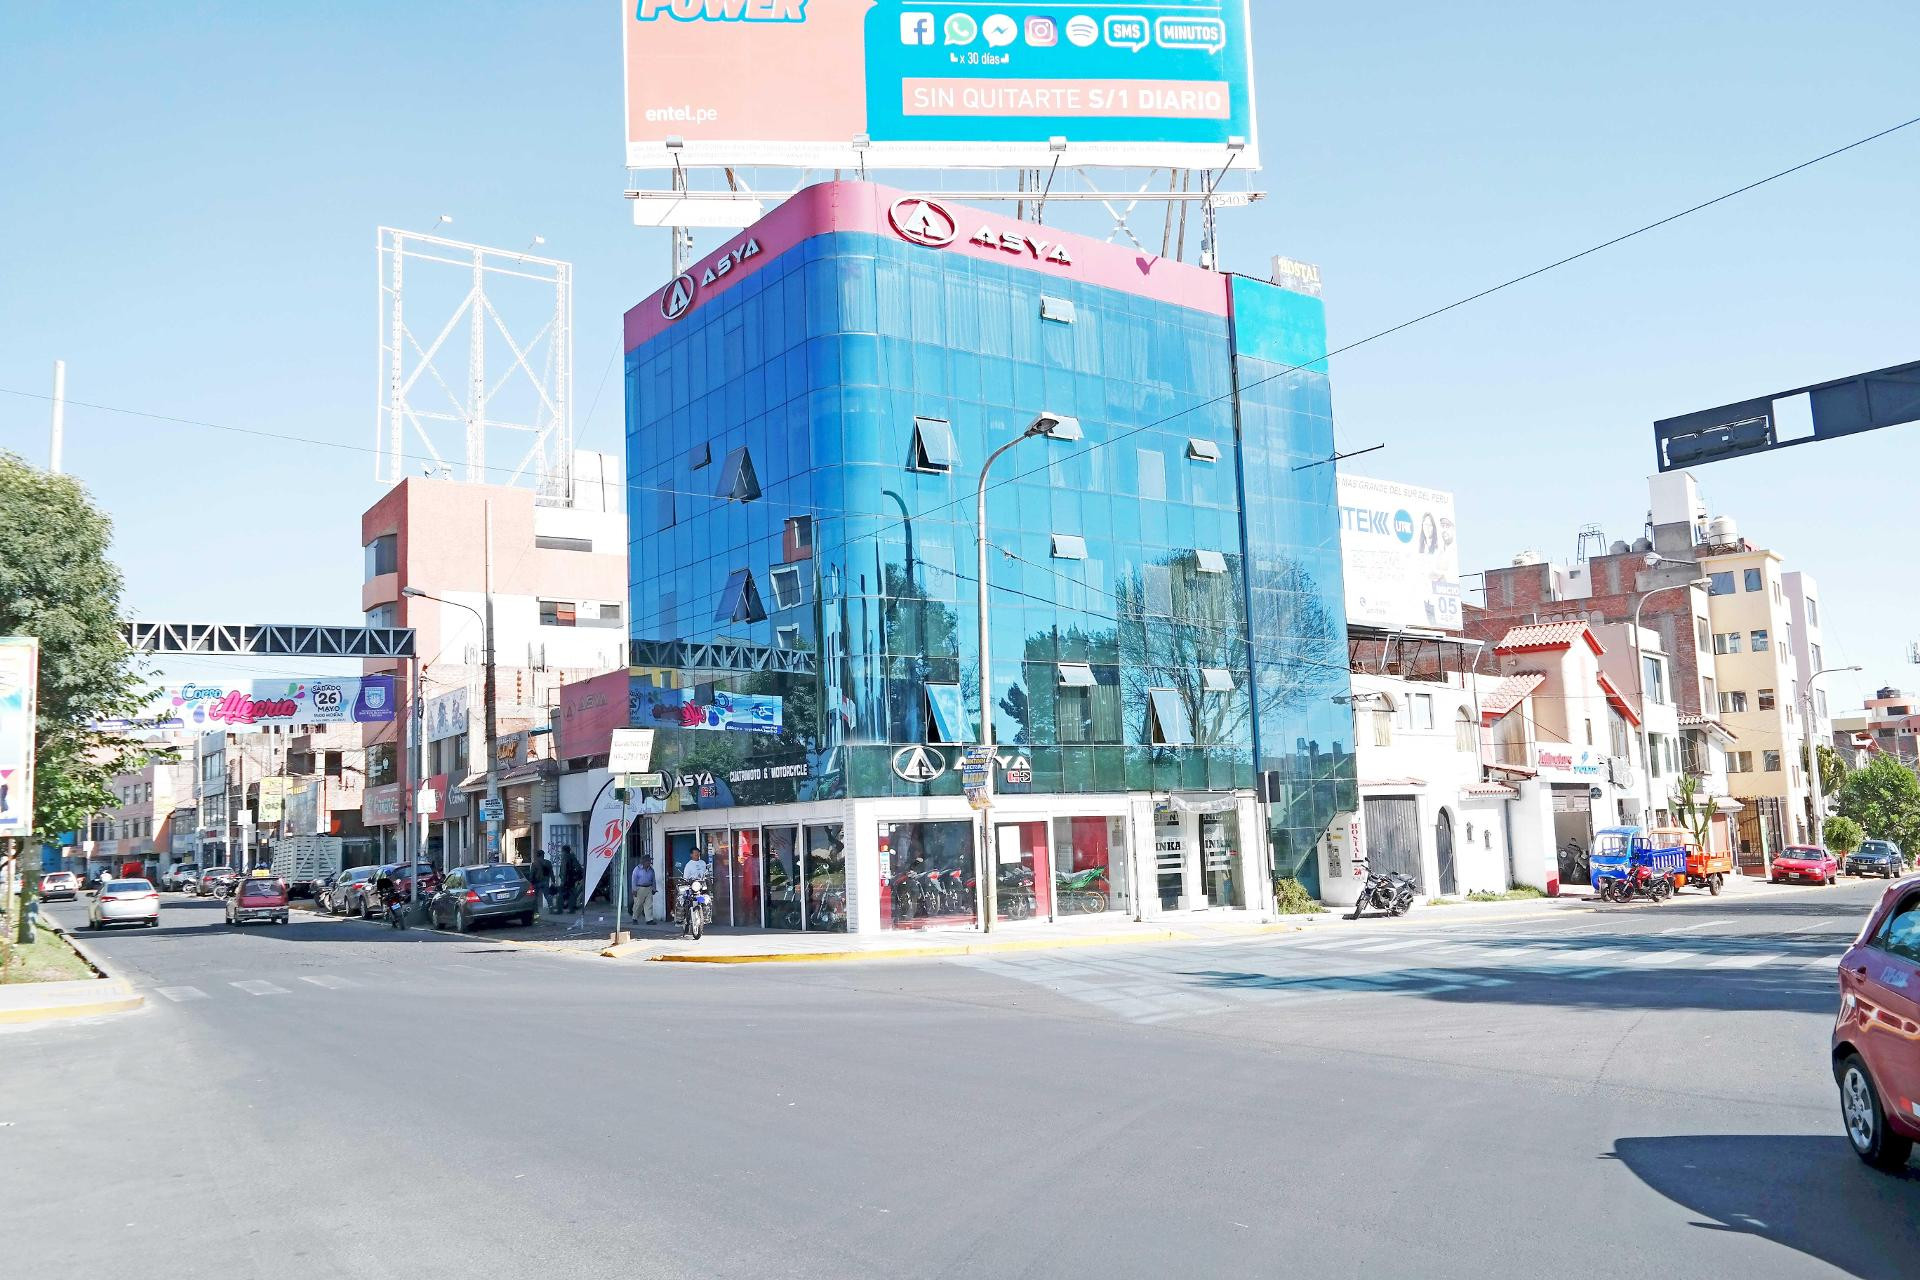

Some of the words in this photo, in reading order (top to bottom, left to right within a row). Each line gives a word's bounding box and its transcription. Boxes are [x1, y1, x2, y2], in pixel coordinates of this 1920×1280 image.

[1113, 24, 1140, 39] SMS
[1164, 25, 1219, 41] MINUTOS
[960, 55, 966, 64] x
[967, 52, 979, 65] 30
[981, 52, 1000, 65] días
[913, 87, 954, 108] SIN
[962, 88, 1081, 110] QUITARTE
[1088, 89, 1128, 109] S/1
[1138, 89, 1221, 111] DIARIO
[645, 105, 718, 124] entel.pe
[969, 225, 1073, 266] ASYA
[701, 238, 761, 288] ASYA
[1279, 258, 1320, 282] HOSTAL
[1438, 596, 1458, 614] 05
[182, 683, 222, 701] Corso
[318, 692, 337, 705] 26
[317, 705, 340, 713] MAYO
[953, 755, 1031, 770] AYA
[674, 772, 715, 788] ASYA
[729, 769, 761, 783] CUATRIMOTO
[770, 763, 808, 778] MOTORCYCLE
